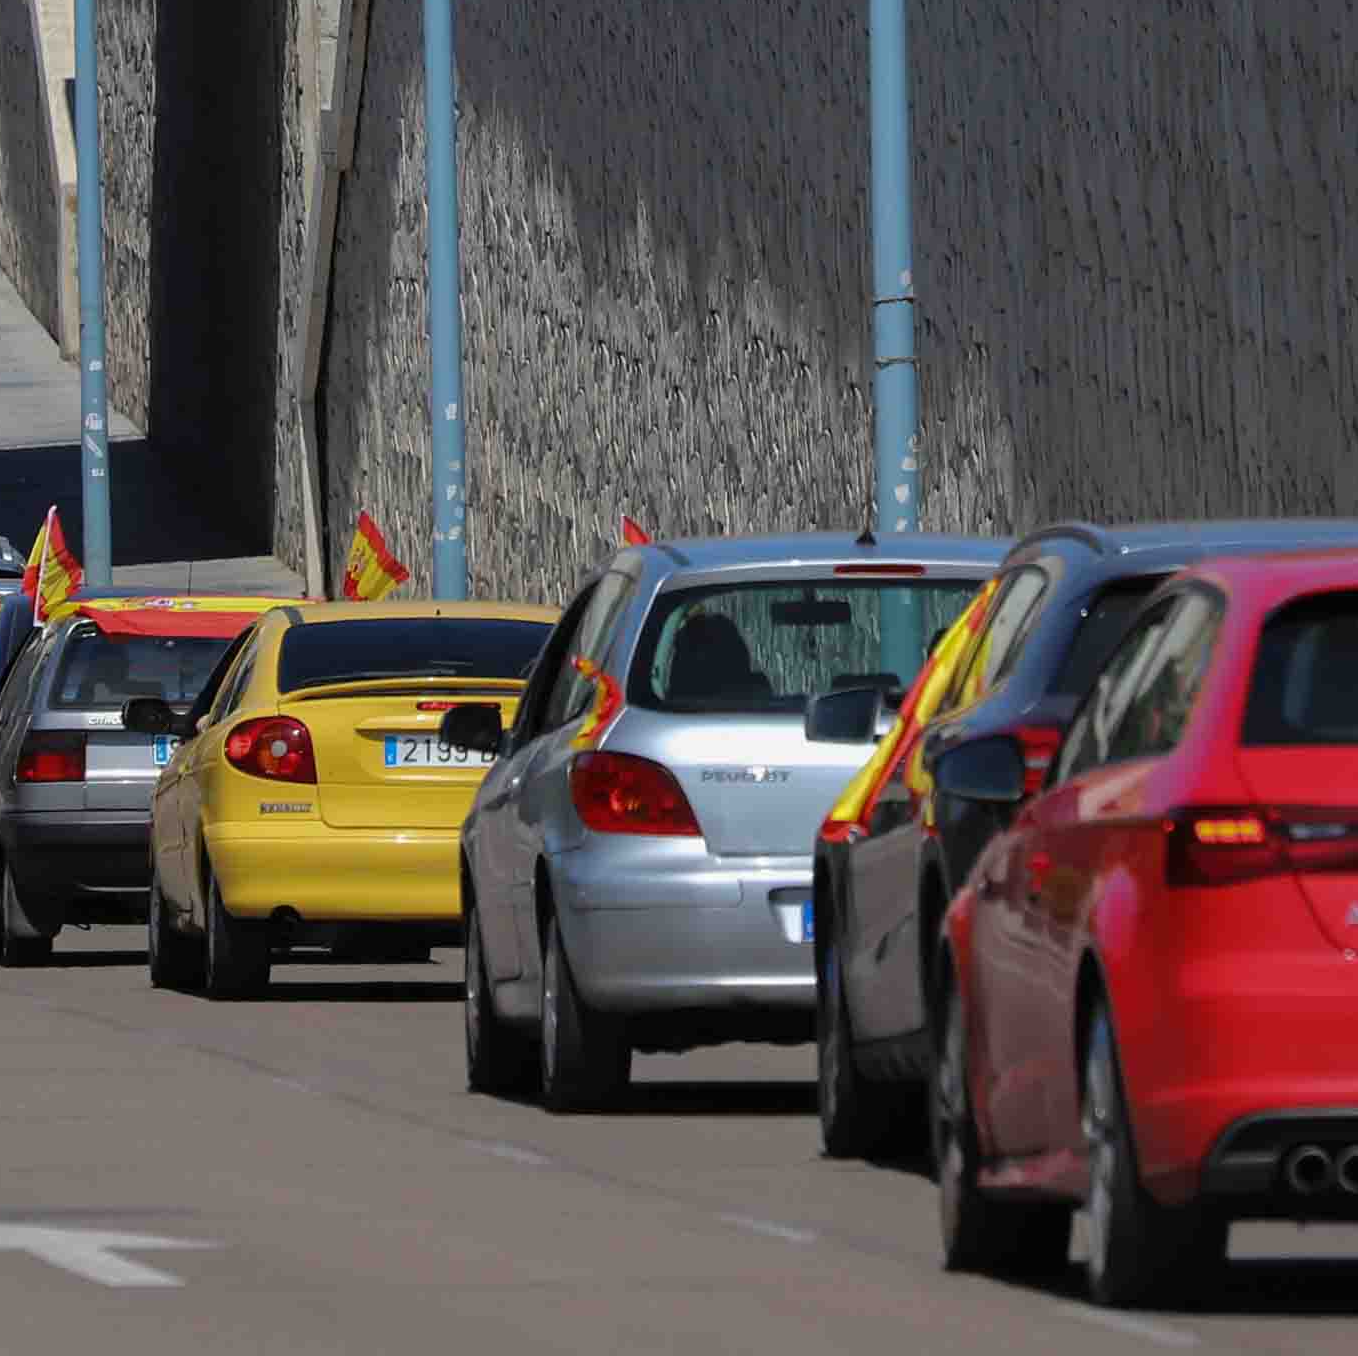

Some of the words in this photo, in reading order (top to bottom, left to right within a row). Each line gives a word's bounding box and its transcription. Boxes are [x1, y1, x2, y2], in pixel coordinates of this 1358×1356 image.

[88, 715, 122, 725] CITRO
[402, 738, 469, 763] 2199
[701, 770, 791, 784] PEUGOT
